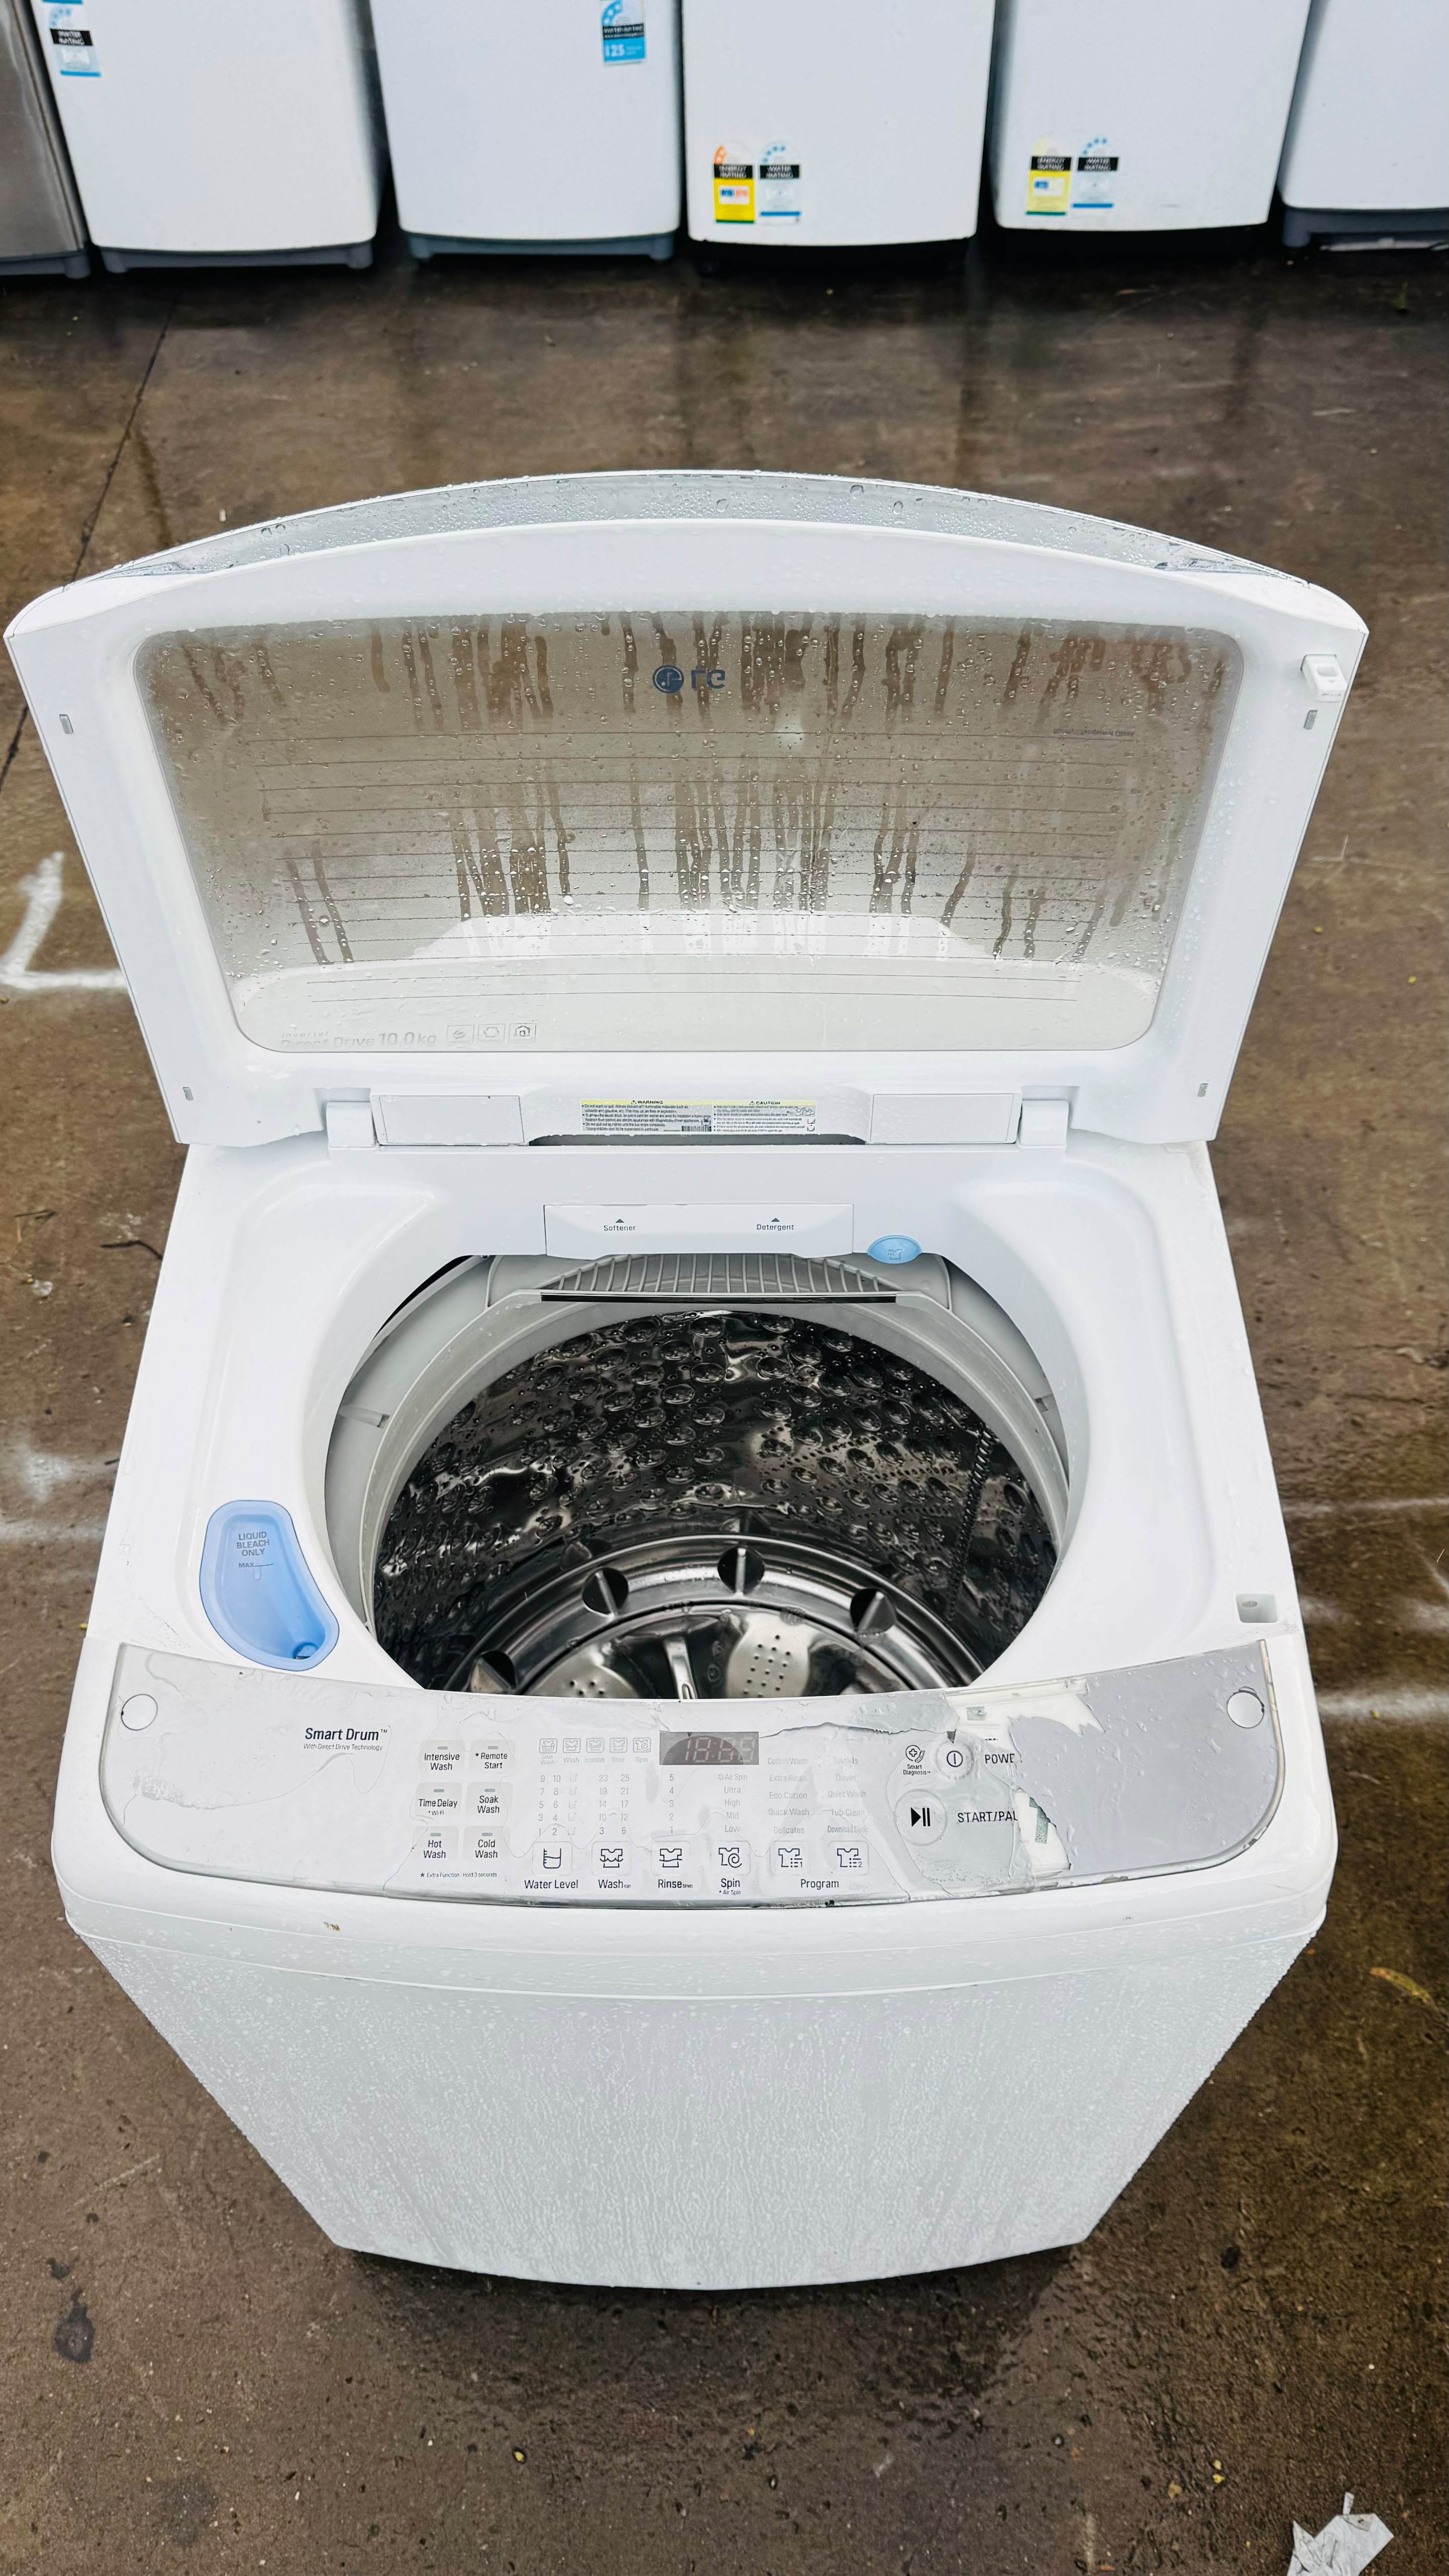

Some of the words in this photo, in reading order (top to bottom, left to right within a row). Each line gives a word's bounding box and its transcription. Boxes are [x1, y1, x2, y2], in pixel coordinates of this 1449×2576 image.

[238, 1532, 267, 1541] LIQUID
[236, 1539, 270, 1549] BLEACH
[242, 1548, 265, 1557] ONLY
[305, 1728, 343, 1740] Smart
[424, 1753, 460, 1761] Intensive
[985, 1753, 1015, 1764] POWE
[430, 1762, 452, 1770] Wash
[553, 1775, 561, 1783] 10
[735, 1774, 748, 1782] Spin
[540, 1788, 544, 1796] 7
[553, 1787, 559, 1796] 8
[600, 1787, 607, 1795] 19
[828, 1790, 846, 1798] Quiet
[479, 1795, 499, 1803] Soak
[725, 1799, 740, 1807] High
[419, 1799, 436, 1807] Time
[437, 1799, 458, 1809] Delay
[539, 1801, 544, 1809] 5
[553, 1801, 558, 1809] 6
[477, 1805, 500, 1813] Wash
[768, 1808, 788, 1816] Quick
[831, 1808, 843, 1816] Tub
[845, 1808, 865, 1816] Clean
[552, 1813, 557, 1821] 4
[599, 1813, 607, 1821] 10
[669, 1813, 674, 1821] 2
[726, 1811, 739, 1819] Mid
[552, 1827, 557, 1835] 2
[599, 1827, 604, 1835] 3
[725, 1824, 740, 1832] Low
[428, 1840, 442, 1848] Hot
[477, 1839, 496, 1847] Cold
[423, 1850, 446, 1859] Wash
[475, 1850, 498, 1859] Wash
[524, 1880, 552, 1889] Water
[554, 1880, 578, 1888] Level
[598, 1880, 623, 1888] Wash
[658, 1879, 682, 1888] Rinse
[721, 1878, 740, 1889] Spin
[800, 1879, 839, 1890] Program
